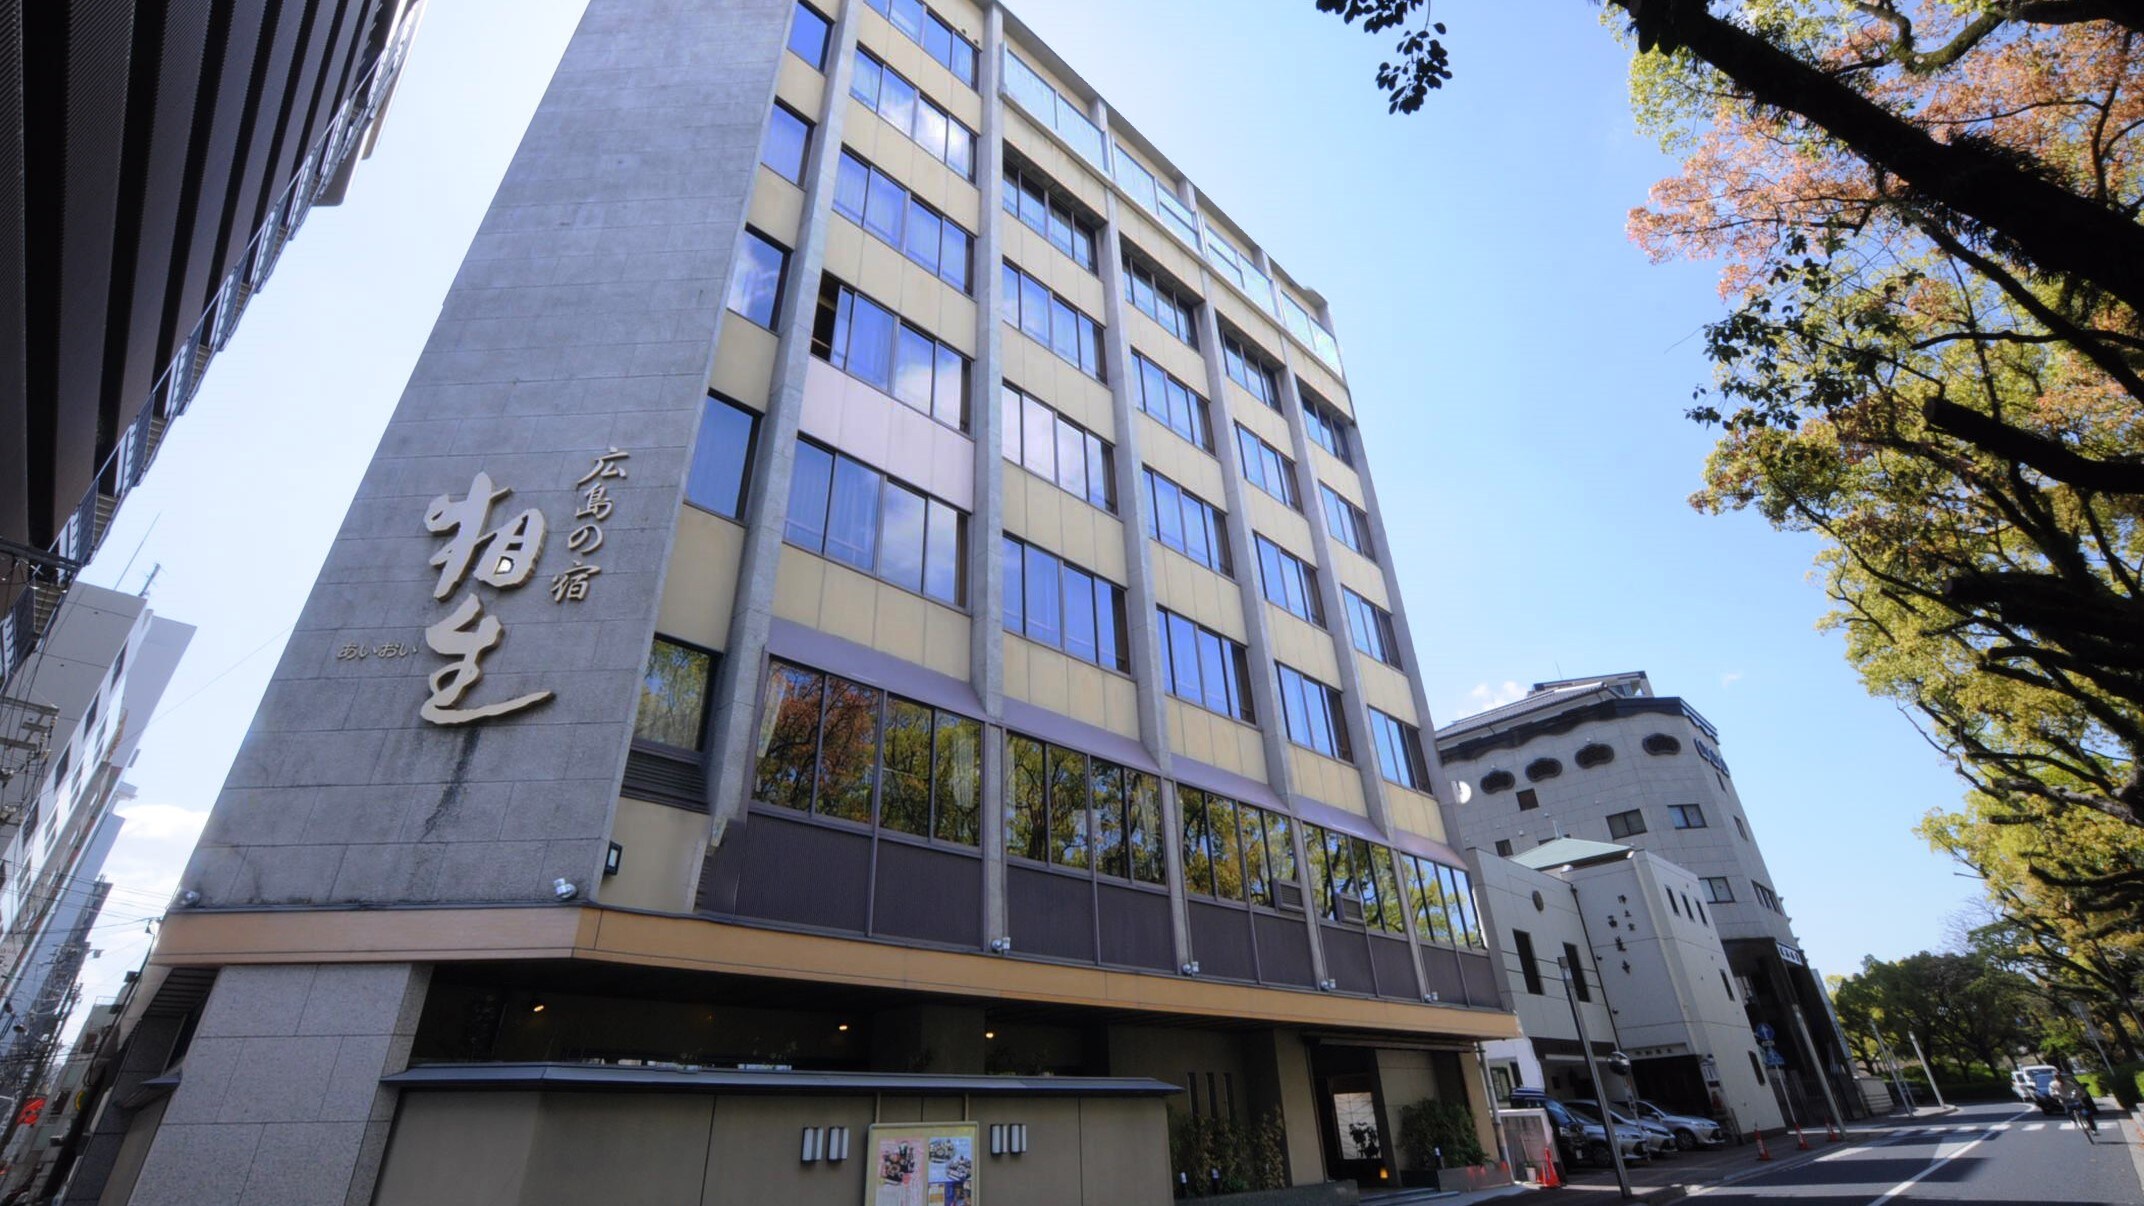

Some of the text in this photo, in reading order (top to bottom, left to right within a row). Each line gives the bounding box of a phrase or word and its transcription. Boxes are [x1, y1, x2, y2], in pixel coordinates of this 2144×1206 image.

[420, 470, 557, 725] 相生
[550, 446, 630, 603] 広島の宿
[336, 642, 419, 661] あいおい
